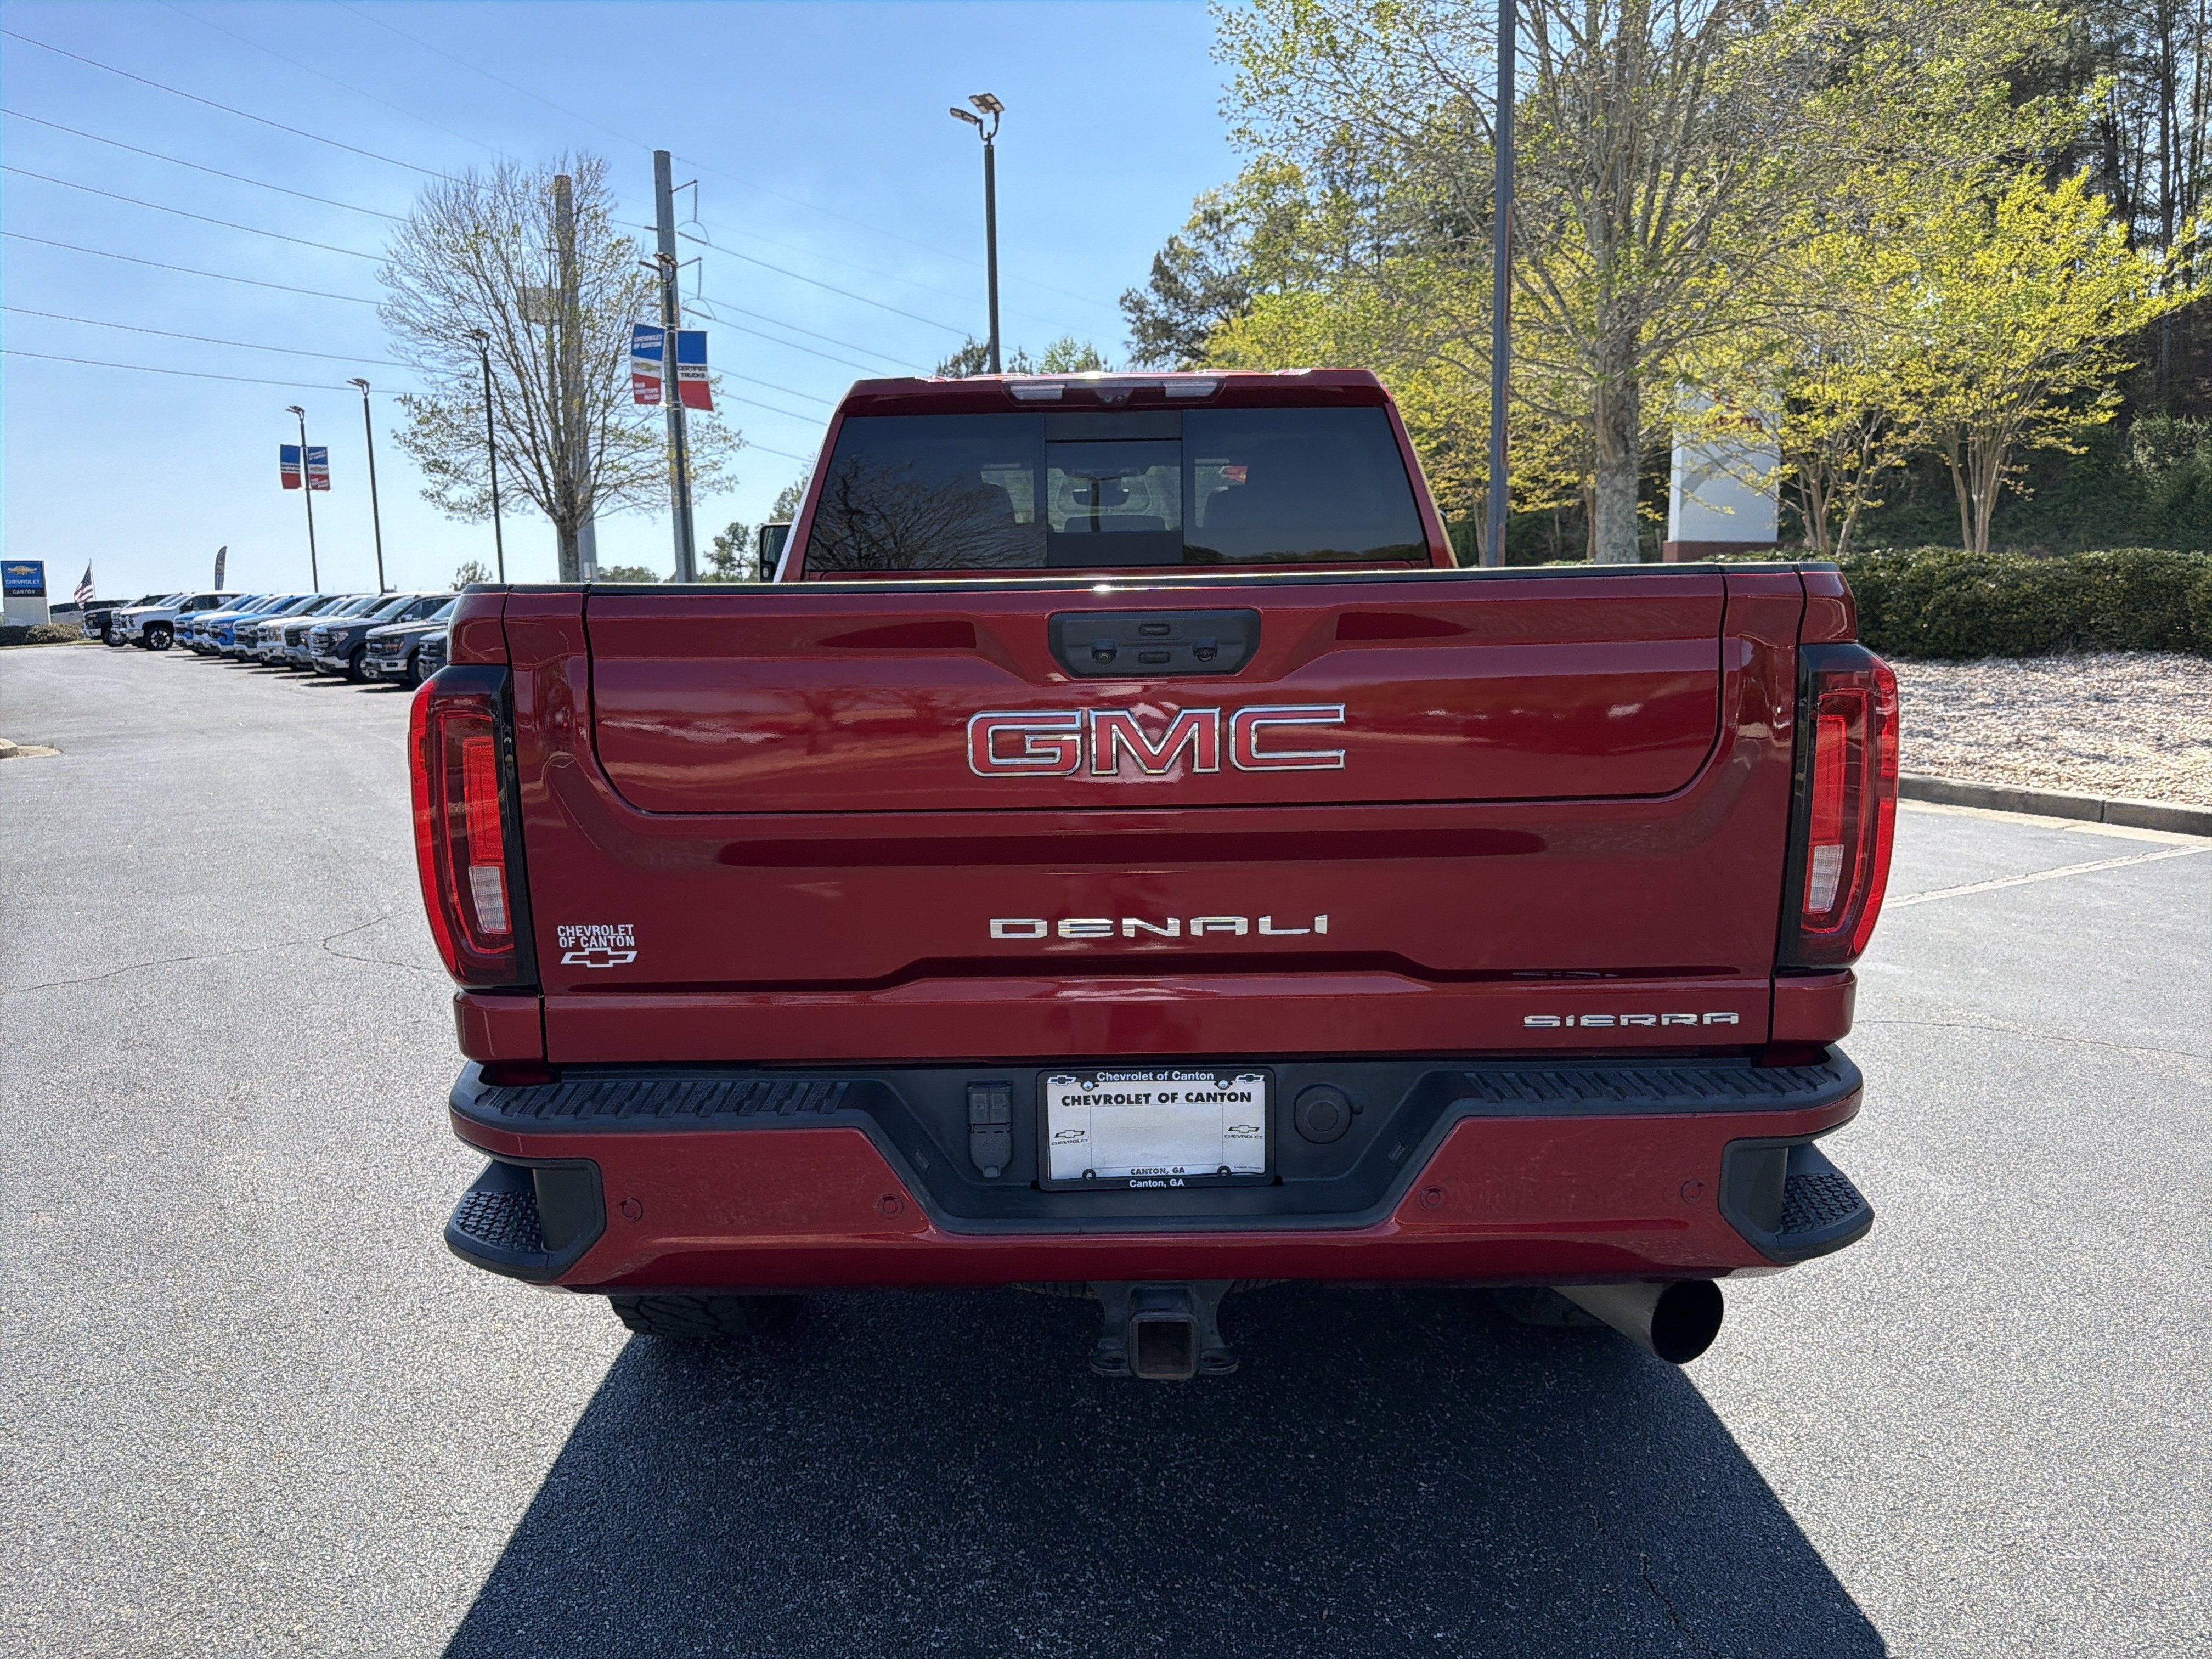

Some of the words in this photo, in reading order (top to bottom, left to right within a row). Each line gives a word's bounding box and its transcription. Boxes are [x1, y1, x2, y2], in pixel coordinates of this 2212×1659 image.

[634, 334, 663, 342] CHEVROLET
[967, 703, 1346, 777] GMC
[557, 924, 634, 937] CHEVROLET
[990, 913, 1328, 939] DENALI
[558, 936, 576, 948] OF
[580, 935, 635, 947] CANTON
[1523, 1012, 1740, 1028] SIERRA
[1097, 1072, 1153, 1081] Chevrolet
[1156, 1071, 1168, 1081] of
[1172, 1071, 1215, 1080] Canton
[1061, 1093, 1152, 1107] CHEVROLET
[1157, 1092, 1179, 1103] OF
[1184, 1092, 1252, 1103] CANTON
[1129, 1180, 1166, 1188] Canton,
[1169, 1178, 1184, 1187] GA
